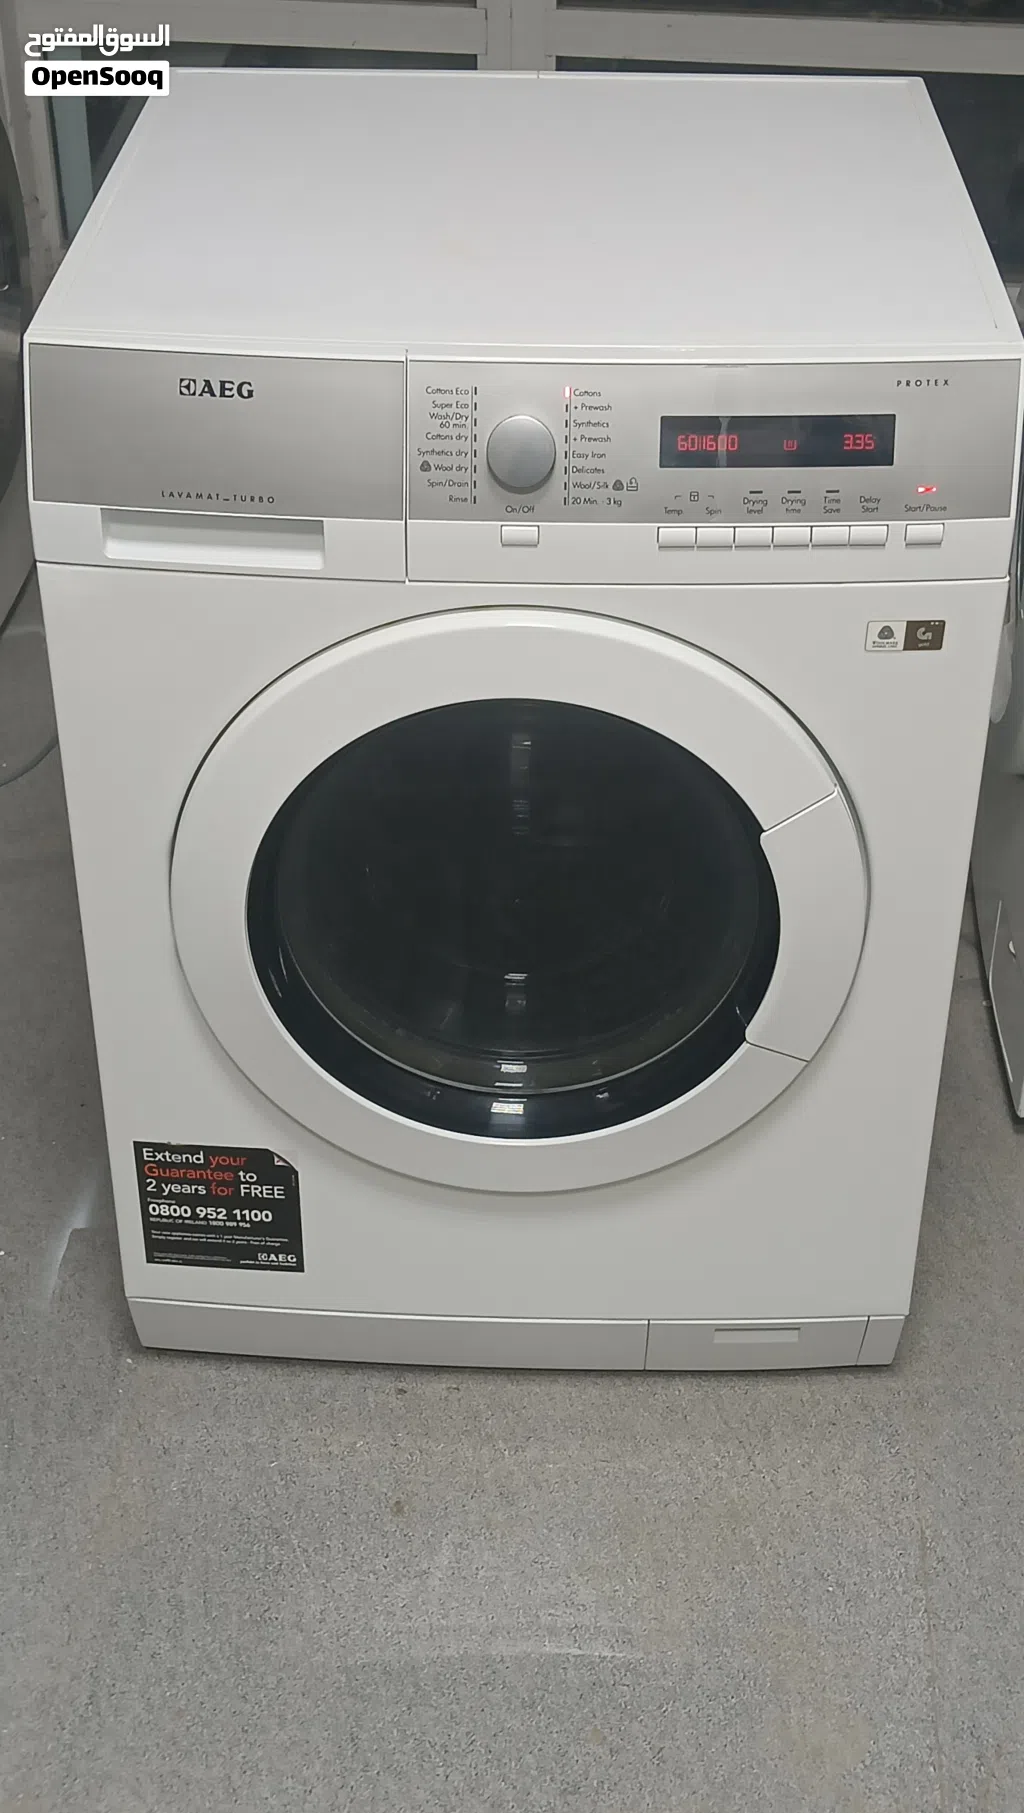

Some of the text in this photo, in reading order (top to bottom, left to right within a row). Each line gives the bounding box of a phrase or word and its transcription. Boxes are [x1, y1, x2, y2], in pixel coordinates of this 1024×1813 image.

[896, 379, 949, 387] PROTEX
[198, 379, 254, 399] AEG
[425, 386, 469, 396] Cottons Eco
[573, 389, 601, 397] Cottons
[432, 400, 469, 409] Super Eco
[581, 402, 612, 411] Prewash
[429, 412, 469, 422] Wash/Dry
[440, 421, 450, 429] 60
[572, 419, 609, 430] Synthetics
[425, 432, 469, 442] Cottons dry
[580, 434, 611, 443] Prewash
[417, 448, 469, 458] Synthetics dry
[572, 450, 606, 460] Easy Iron
[433, 463, 469, 473] Wool dry
[571, 465, 605, 474] Delicates
[427, 479, 469, 488] Spin/Drain
[448, 495, 469, 503] Rinse
[571, 497, 581, 505] 20
[606, 497, 612, 505] 3
[613, 497, 622, 507] kg
[743, 496, 768, 507] Drying
[781, 496, 806, 506] Drying
[824, 496, 841, 504] Time
[860, 496, 881, 504] Delay
[505, 504, 535, 514] On/Off
[705, 506, 722, 516] Spin
[746, 506, 764, 514] level
[823, 505, 841, 514] Save
[861, 505, 879, 513] Start
[904, 504, 947, 513] Start/Pause
[142, 1148, 247, 1168] Extend your
[144, 1163, 257, 1182] Guarantee to
[146, 1178, 286, 1199] 2 years for FREE
[148, 1203, 272, 1222] 0800 952 1100
[269, 1253, 297, 1262] AEG
